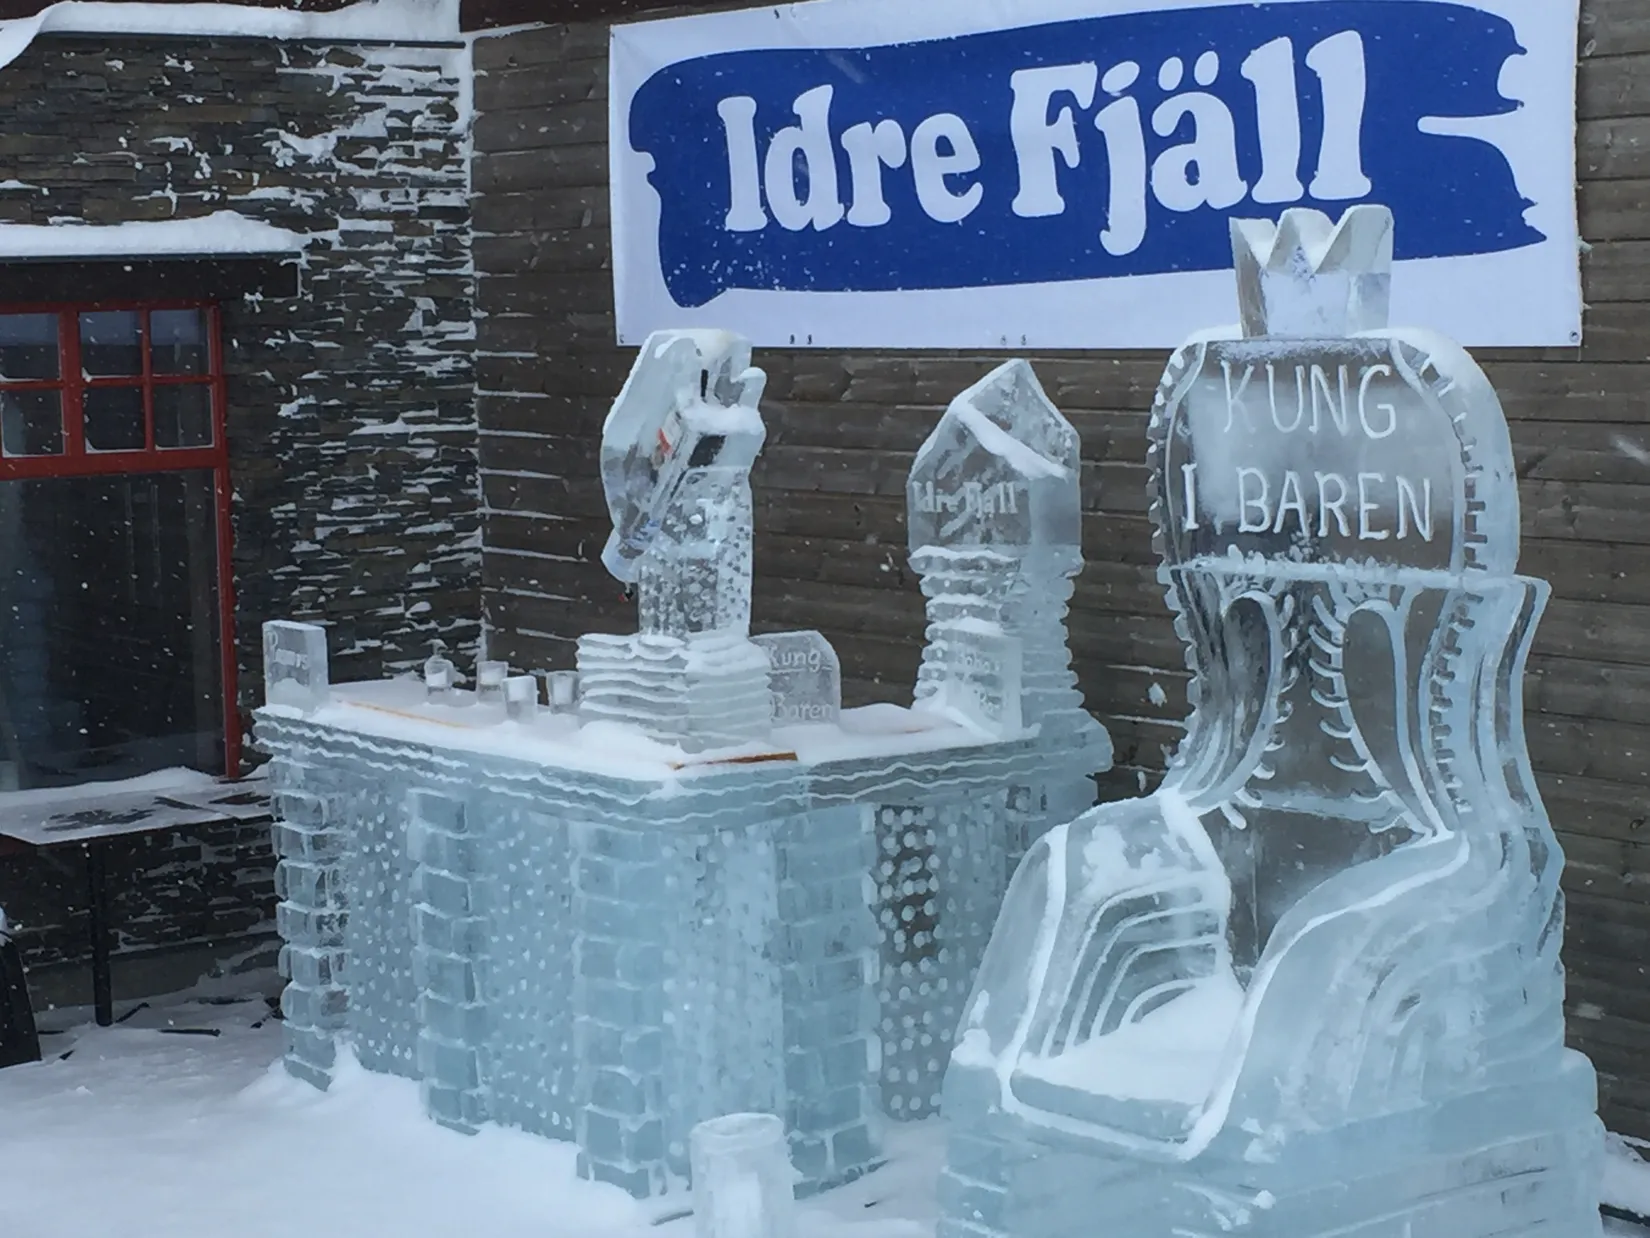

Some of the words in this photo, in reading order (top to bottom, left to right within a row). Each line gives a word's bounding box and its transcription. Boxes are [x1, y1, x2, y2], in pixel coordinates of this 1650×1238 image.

[717, 84, 983, 232] Idre
[1011, 30, 1372, 257] Fjäll
[1220, 360, 1397, 440] KUNG
[1181, 463, 1200, 531] I
[1236, 467, 1434, 542] BAREN
[768, 644, 821, 673] Kung
